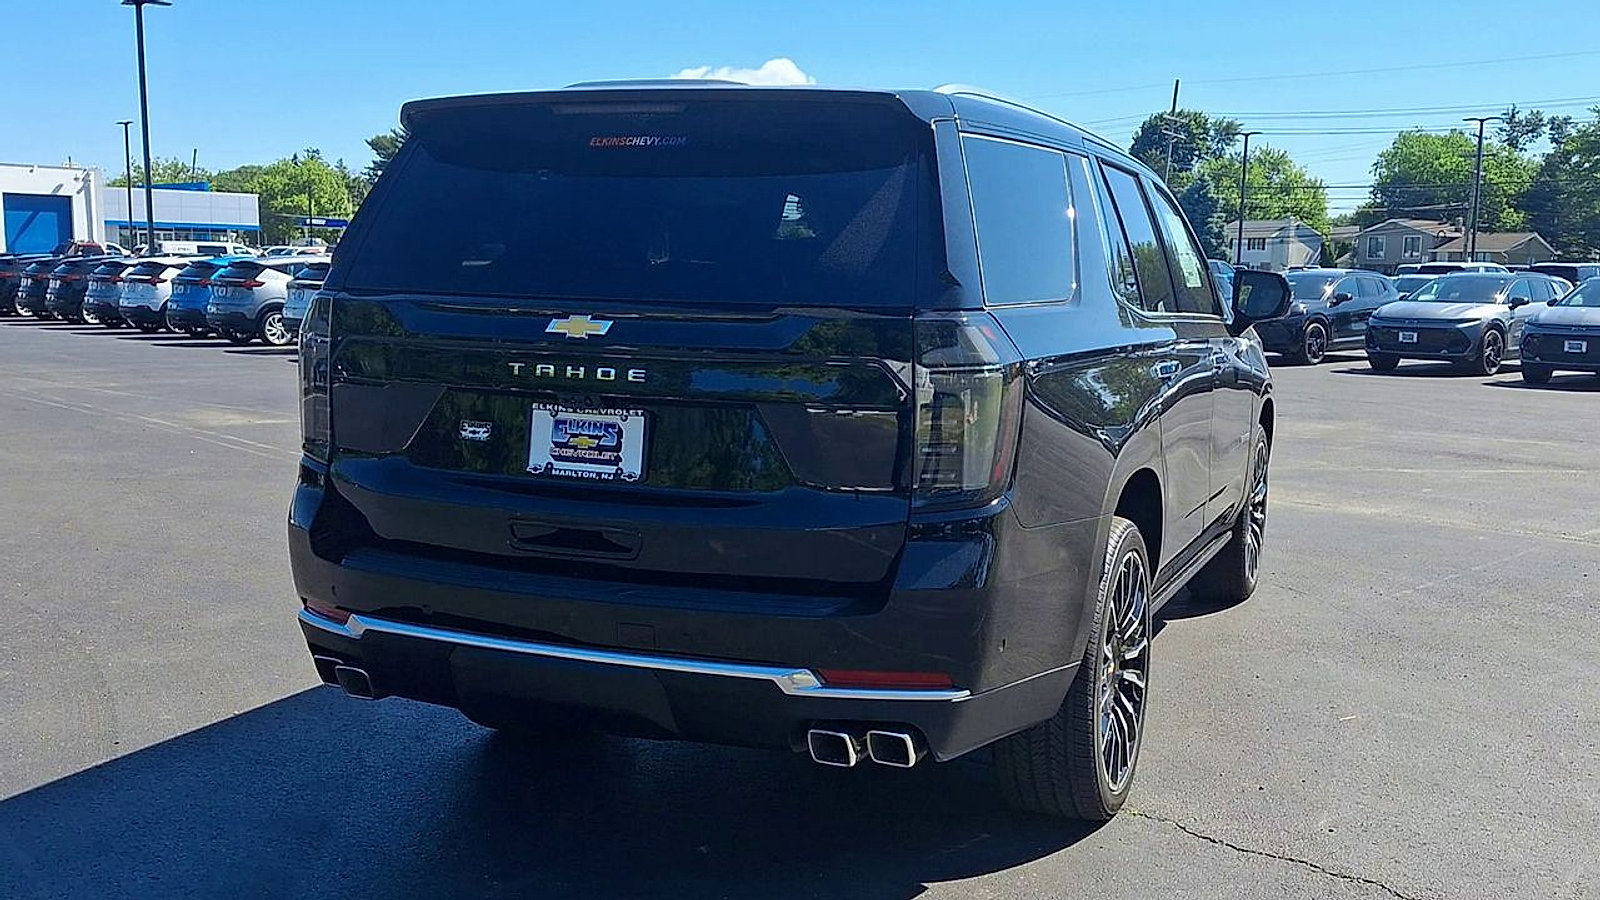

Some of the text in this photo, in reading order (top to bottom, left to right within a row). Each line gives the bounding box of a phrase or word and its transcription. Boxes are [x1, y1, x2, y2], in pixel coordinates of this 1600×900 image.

[590, 136, 686, 147] ELKINSCHEVY.COM
[508, 362, 647, 382] TAHOE
[552, 418, 621, 446] ELKINS
